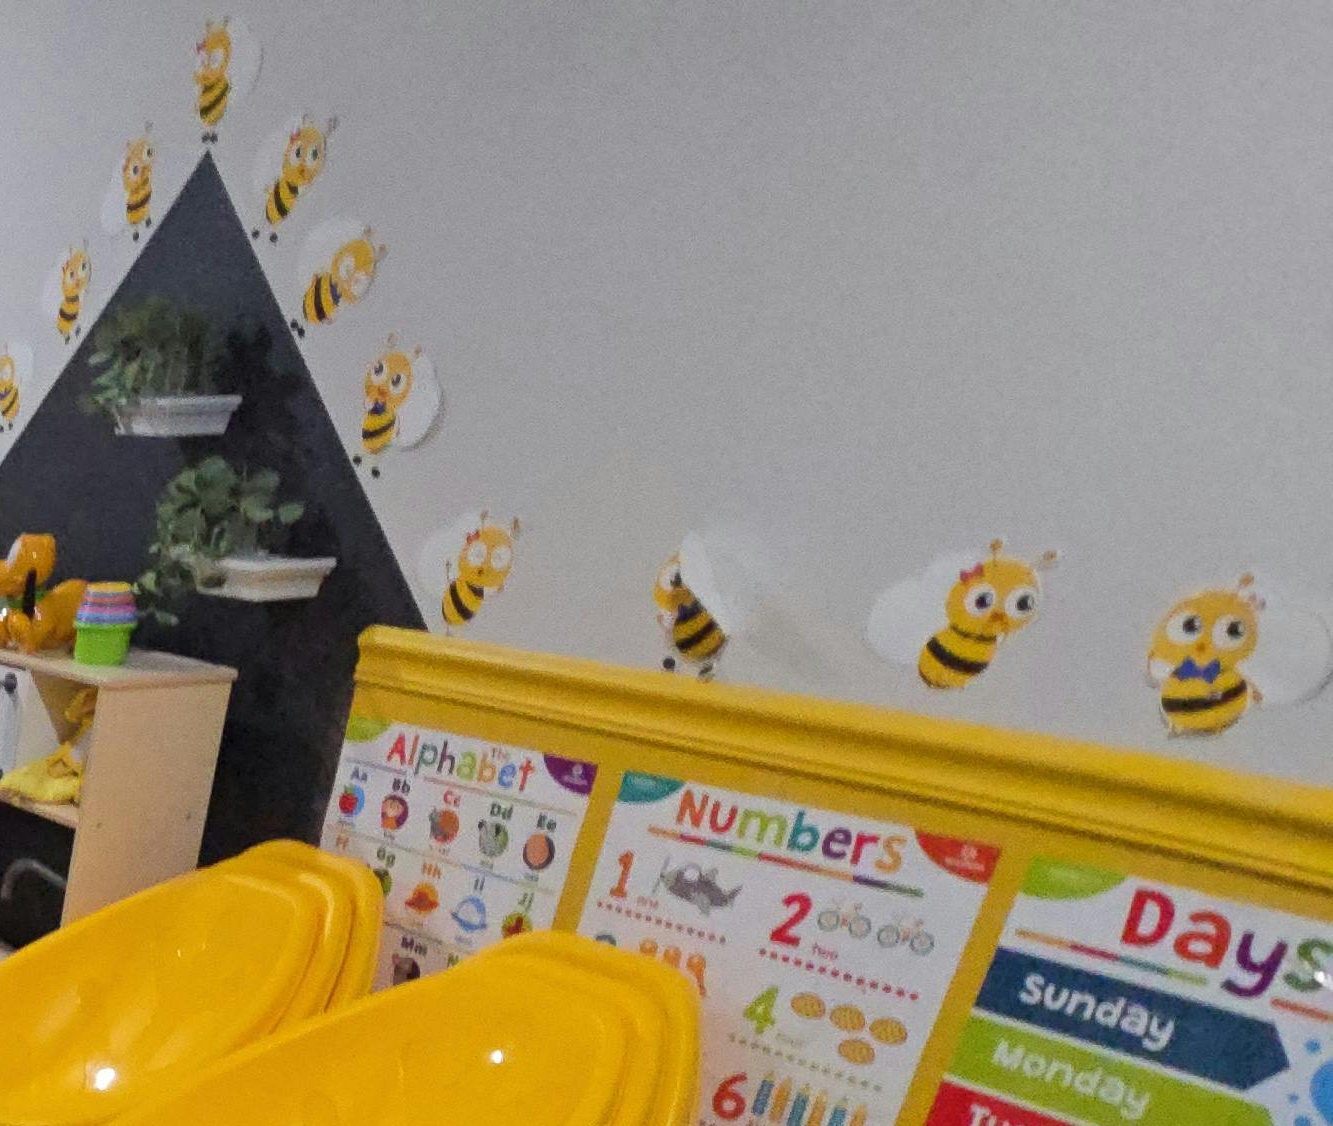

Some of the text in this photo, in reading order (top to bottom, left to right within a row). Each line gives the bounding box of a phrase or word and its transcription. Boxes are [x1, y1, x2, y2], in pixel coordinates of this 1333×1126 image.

[387, 732, 536, 792] Alphabet
[675, 788, 910, 874] Numbers
[607, 851, 635, 900] 1
[770, 892, 814, 948] 2
[1119, 886, 1333, 999] Days
[743, 985, 780, 1035] 4
[1018, 972, 1177, 1051] Sunday
[712, 1071, 748, 1121] 6
[991, 1039, 1151, 1120] Monday
